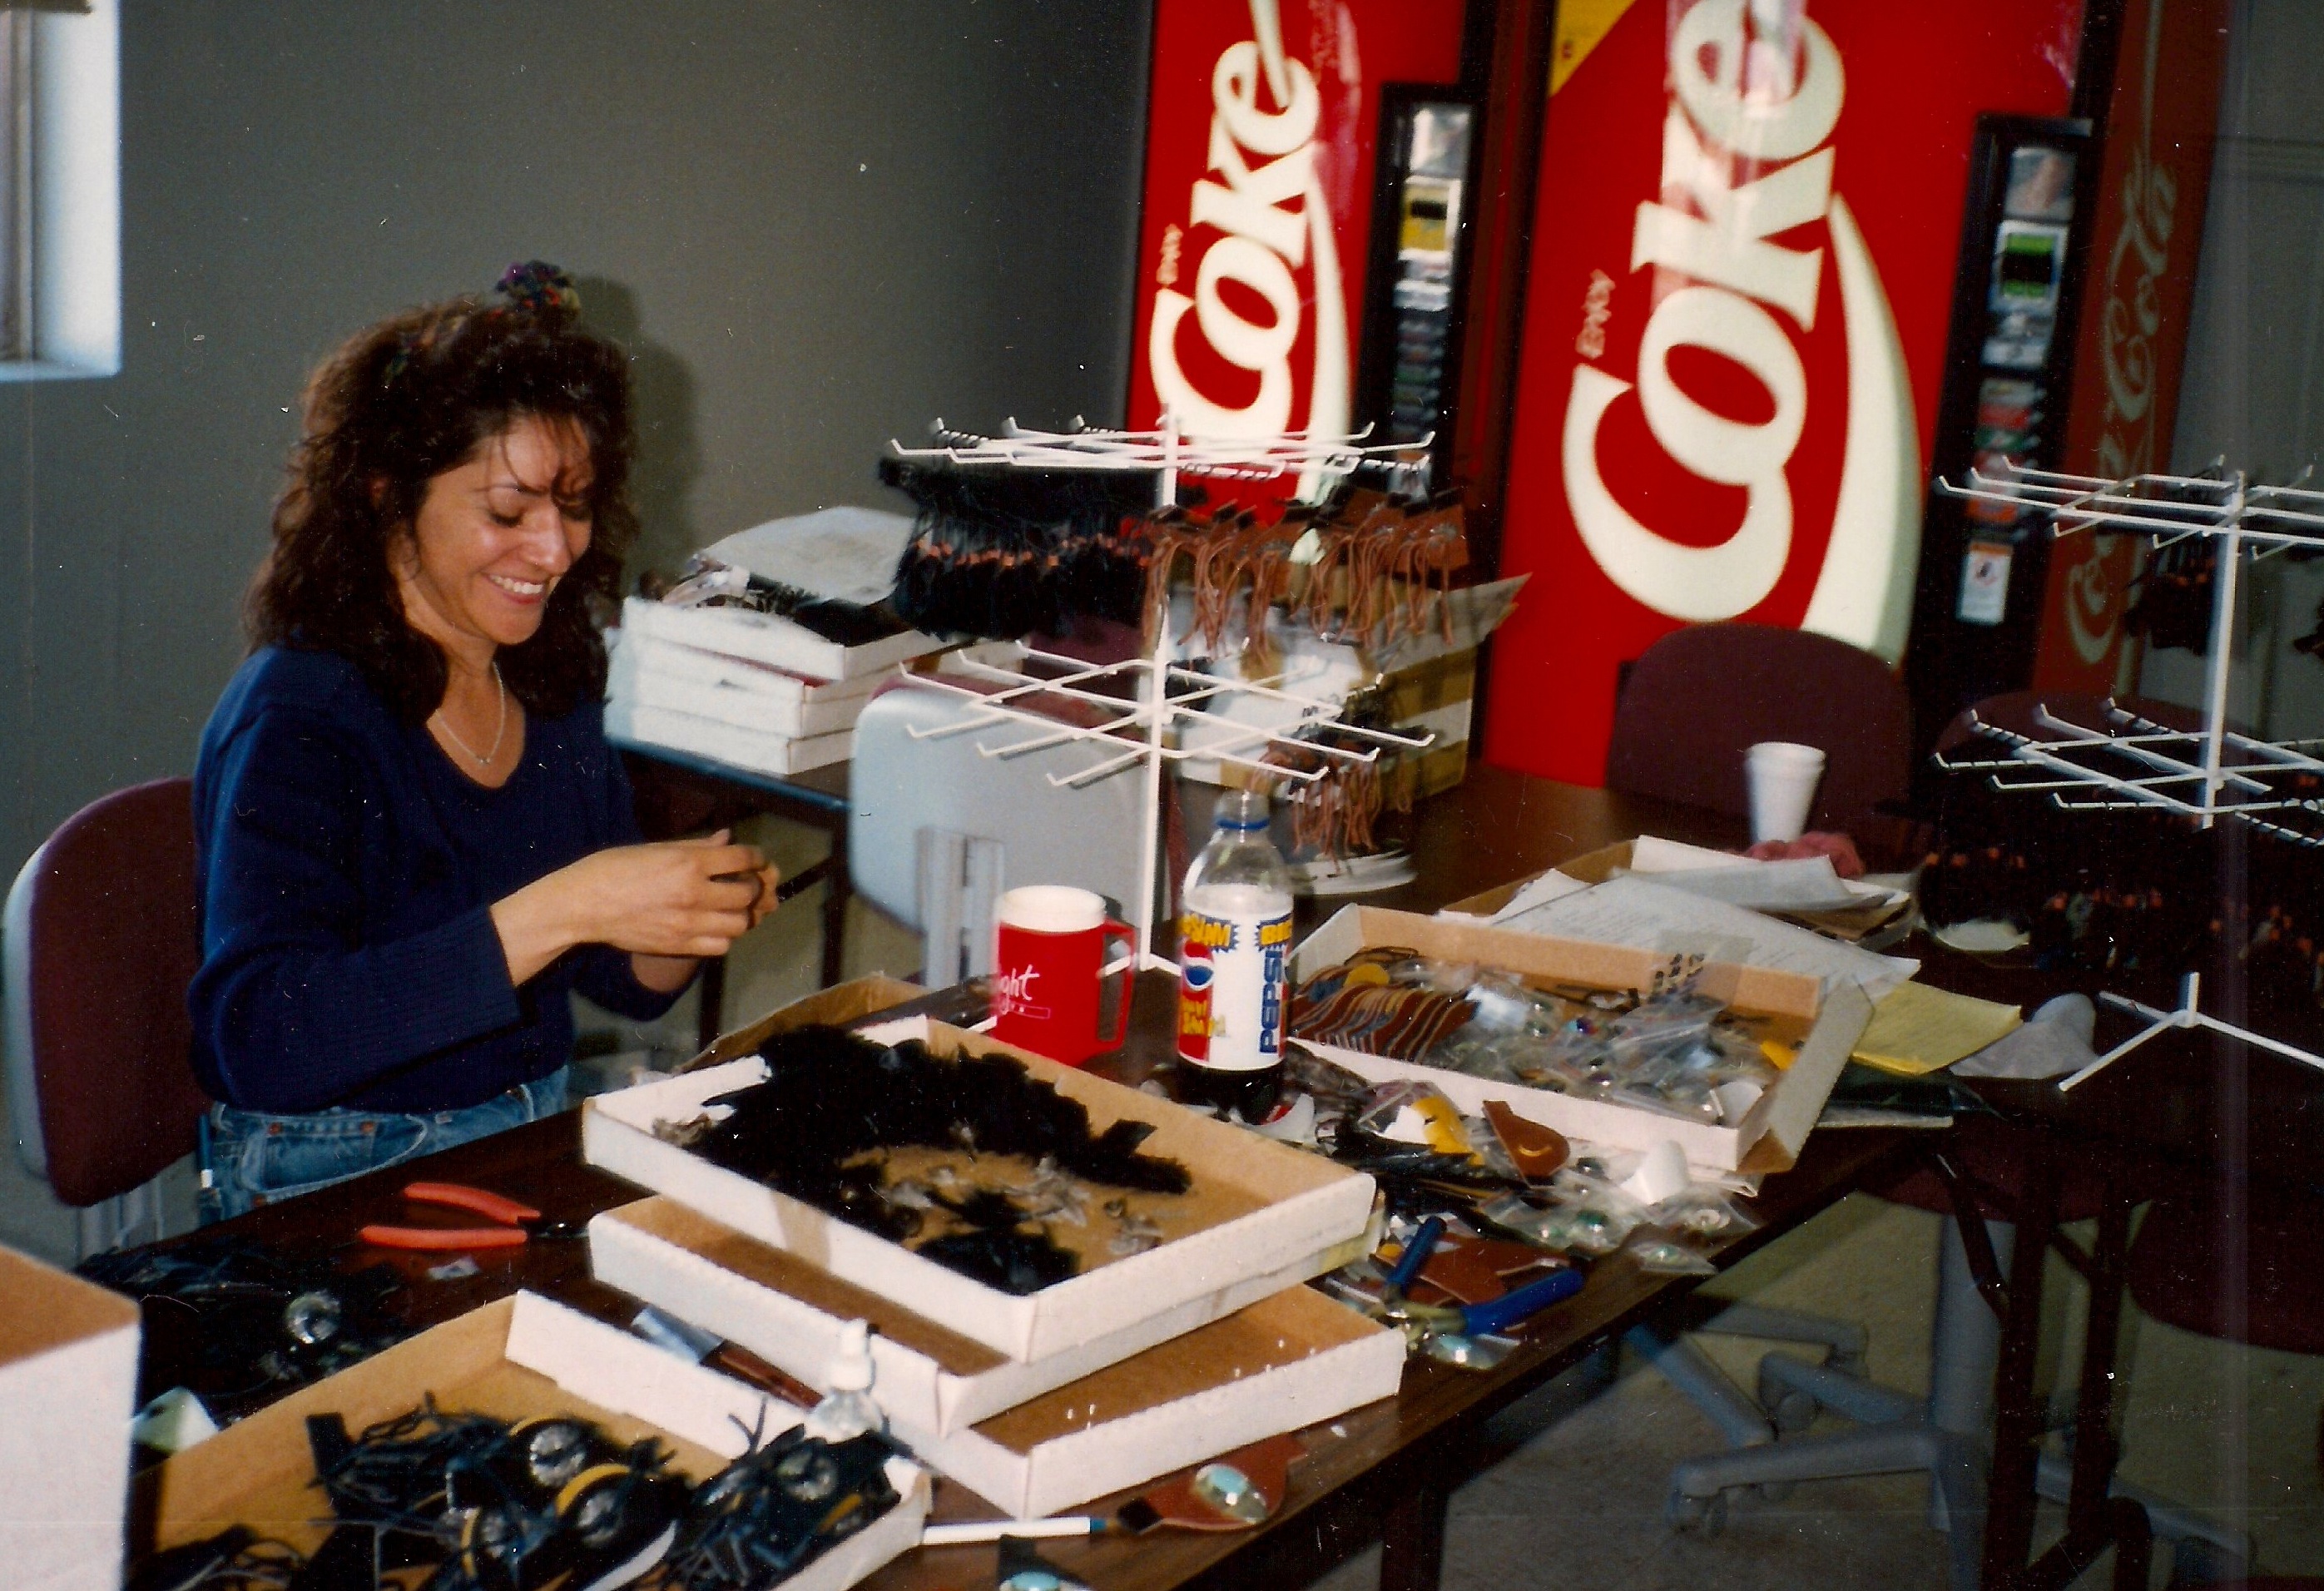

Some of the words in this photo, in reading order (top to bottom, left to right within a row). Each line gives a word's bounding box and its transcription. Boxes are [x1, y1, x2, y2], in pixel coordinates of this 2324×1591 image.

[1149, 40, 1321, 463] Coke
[1562, 0, 1846, 622] Coke
[1259, 950, 1283, 1053] PEPSI
